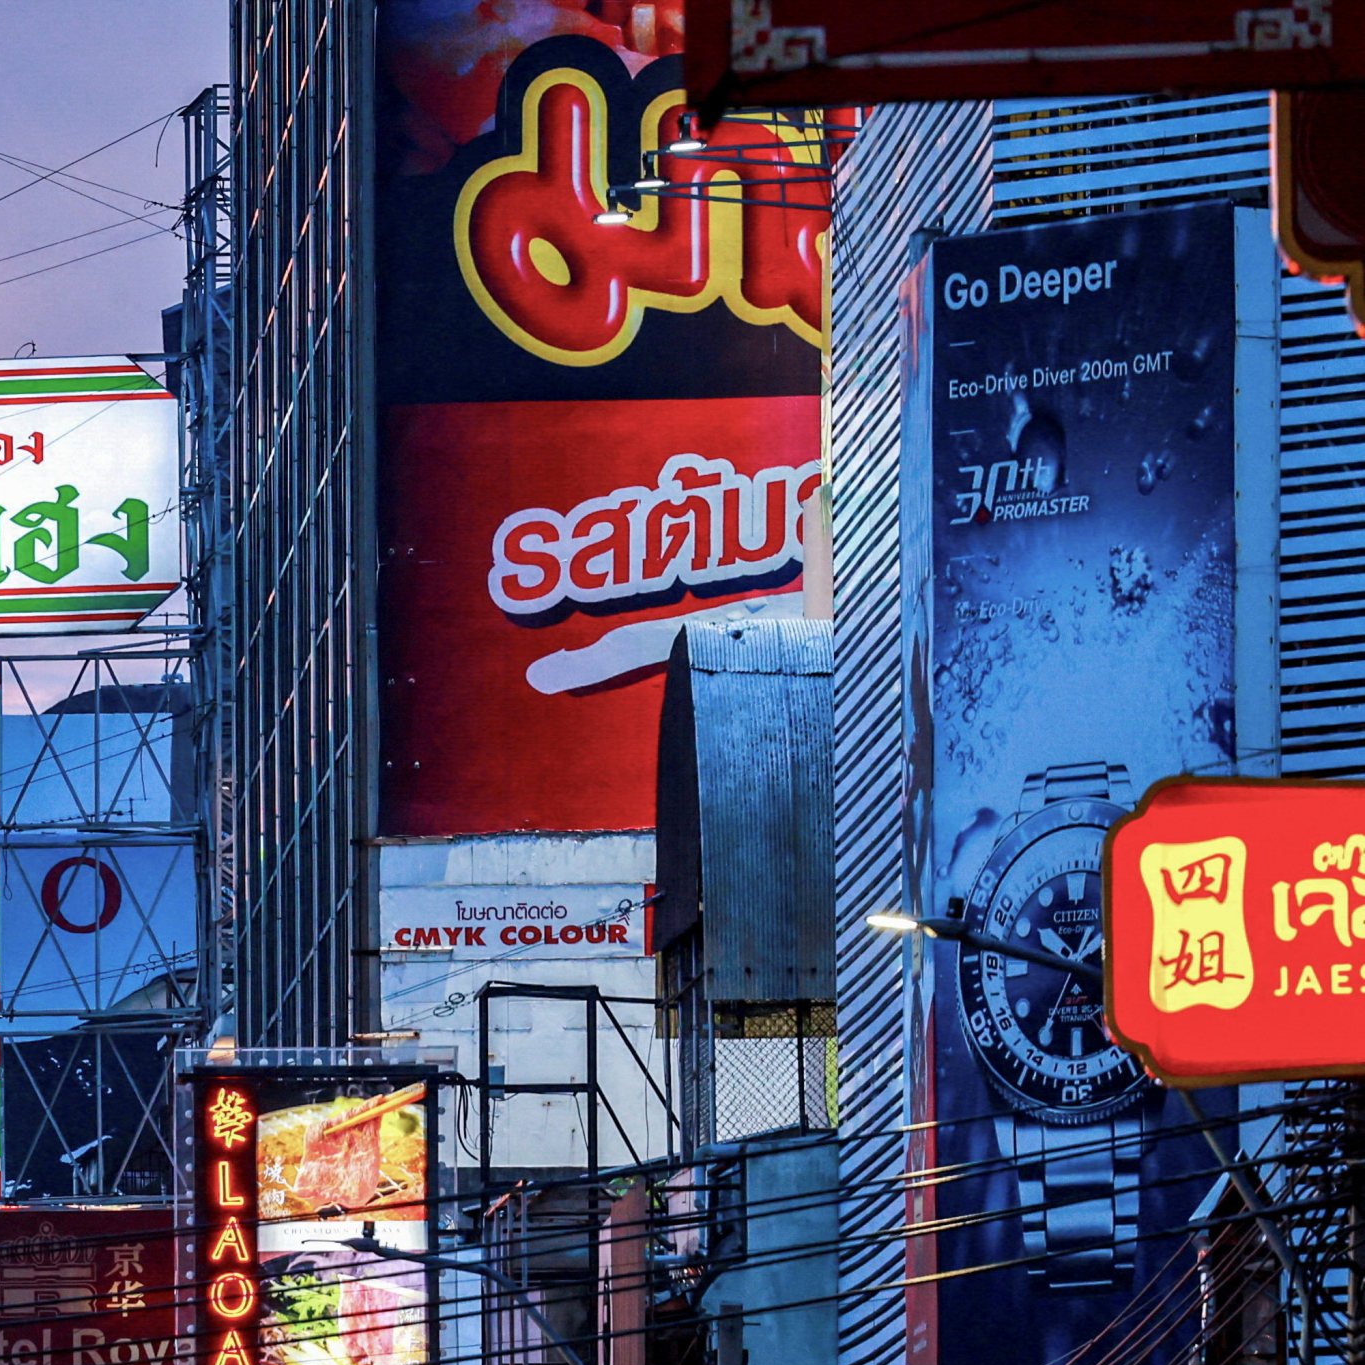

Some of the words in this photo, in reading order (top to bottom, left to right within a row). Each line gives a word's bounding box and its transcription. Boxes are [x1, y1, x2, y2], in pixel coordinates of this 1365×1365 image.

[944, 272, 989, 310] Go
[999, 260, 1118, 304] Deeper
[949, 373, 1028, 399] Eco-Drive
[1033, 366, 1077, 388] Diver
[1081, 359, 1129, 381] 200m
[1133, 351, 1173, 374] GMT
[993, 495, 1090, 522] PROMASTER
[455, 900, 568, 922] โฆษณาติดต่อ
[1053, 908, 1100, 923] CITIZEN
[1159, 852, 1246, 990] 四姐
[394, 926, 487, 947] CMYK
[499, 923, 628, 946] COLOUR
[1068, 1061, 1087, 1075] 12
[104, 1242, 147, 1318] 京华
